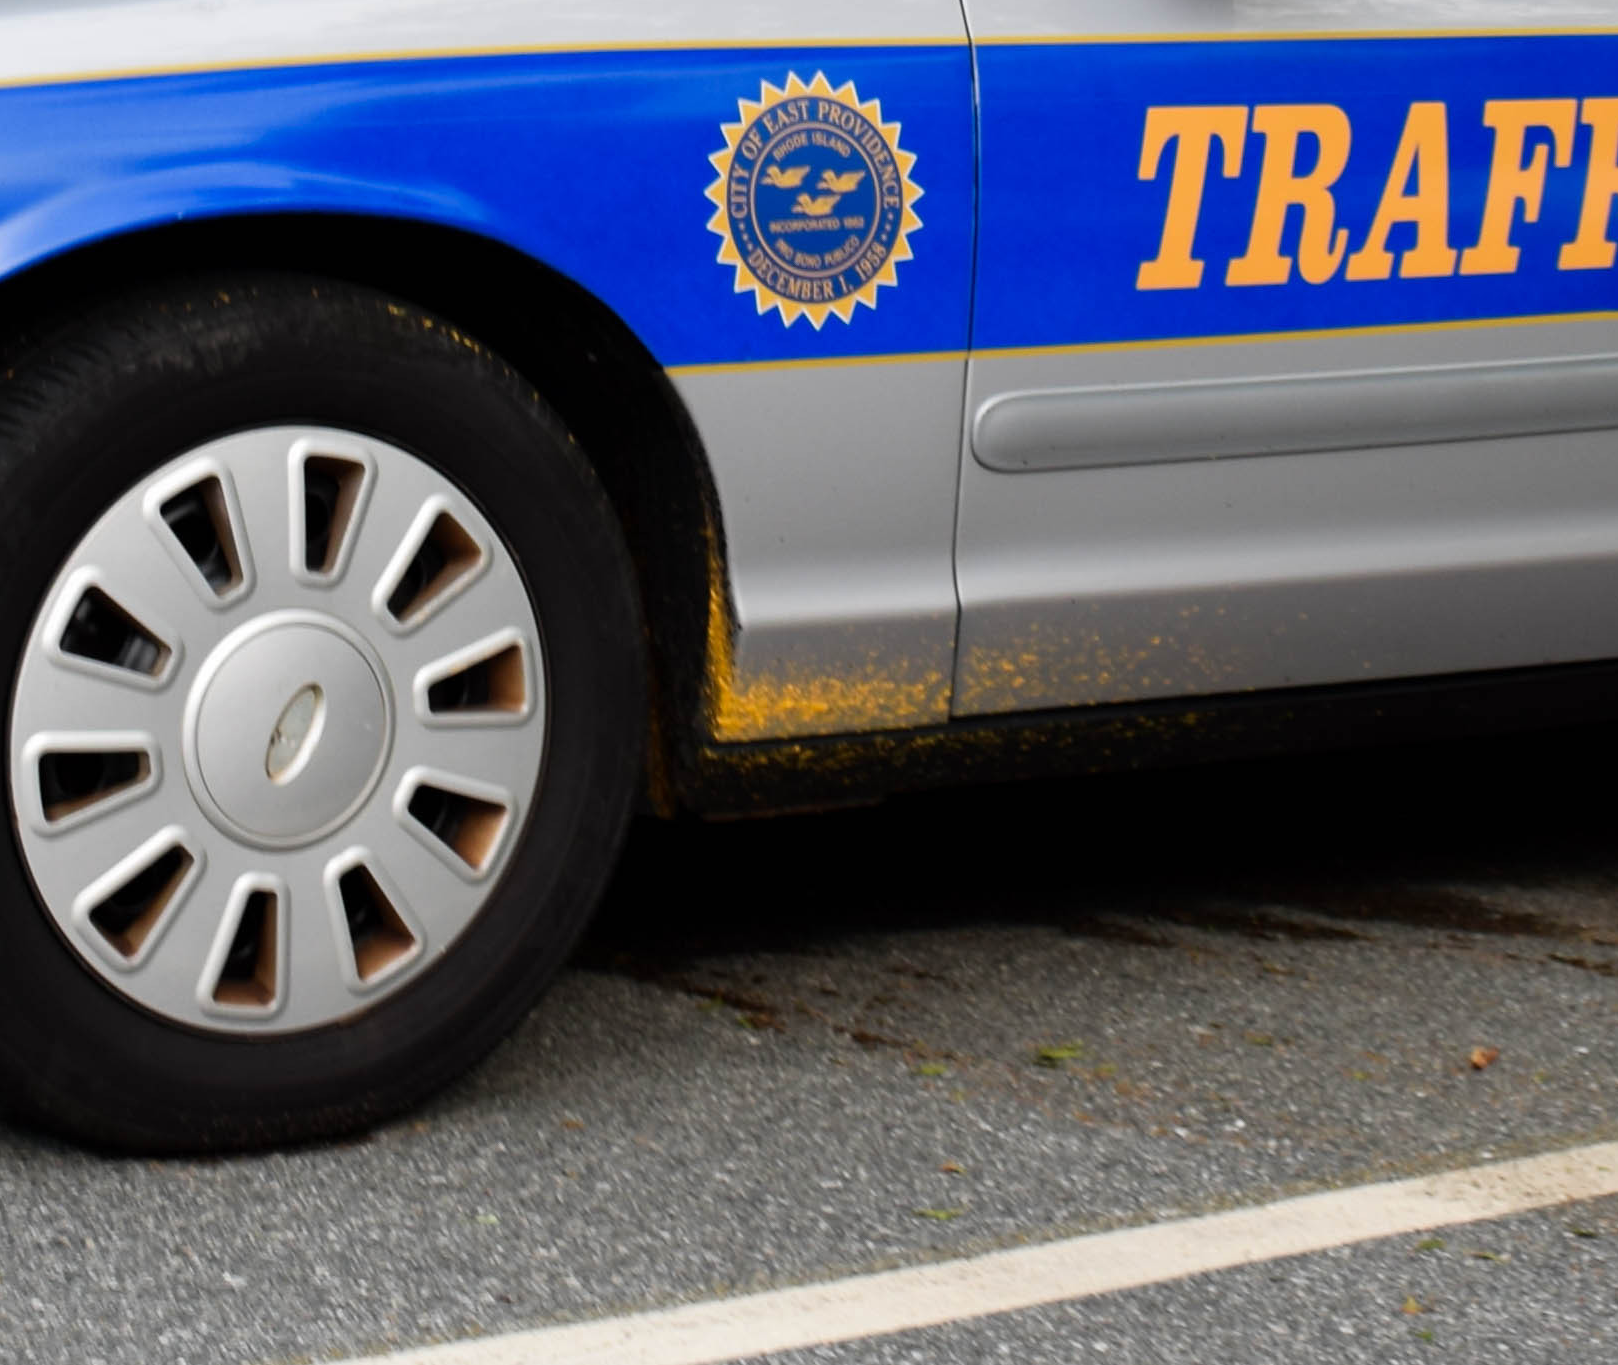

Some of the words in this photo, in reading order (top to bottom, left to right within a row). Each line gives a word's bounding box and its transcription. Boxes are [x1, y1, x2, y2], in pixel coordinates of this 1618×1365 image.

[731, 162, 750, 218] CITY
[742, 127, 762, 160] OF
[763, 100, 809, 134] EAST
[818, 101, 899, 209] PROVIDENCE
[773, 132, 808, 162] RHODE
[812, 132, 850, 158] ISLAND
[748, 246, 835, 301] DECEMBER
[855, 242, 887, 282] 1958
